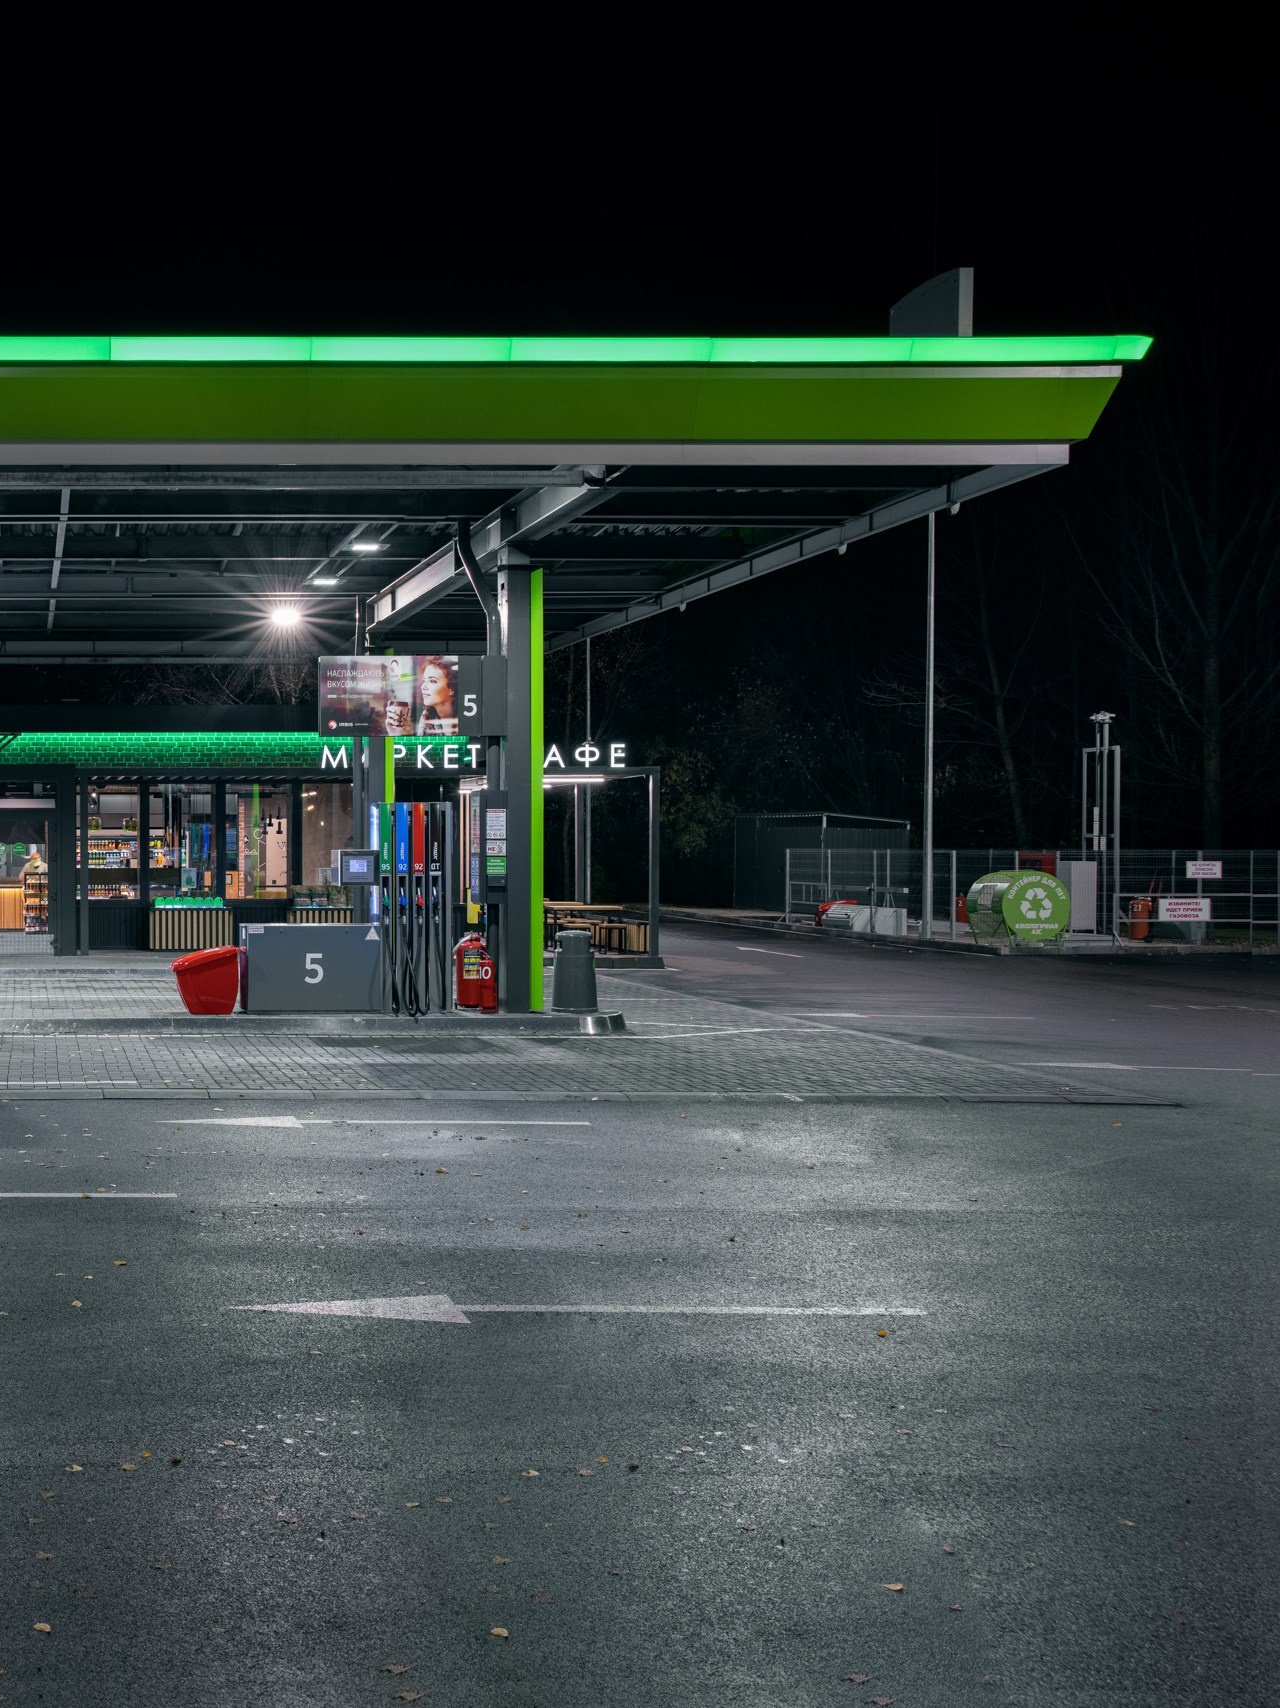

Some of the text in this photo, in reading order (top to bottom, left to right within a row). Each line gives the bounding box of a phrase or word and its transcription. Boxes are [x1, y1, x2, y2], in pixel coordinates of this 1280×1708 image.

[463, 694, 477, 717] 5
[321, 744, 625, 768] МРКЕТ АФЕ
[1008, 875, 1040, 899] КОНТЕЙНЕР
[1133, 904, 1141, 912] 21
[304, 953, 324, 984] 5
[480, 966, 491, 979] 10
